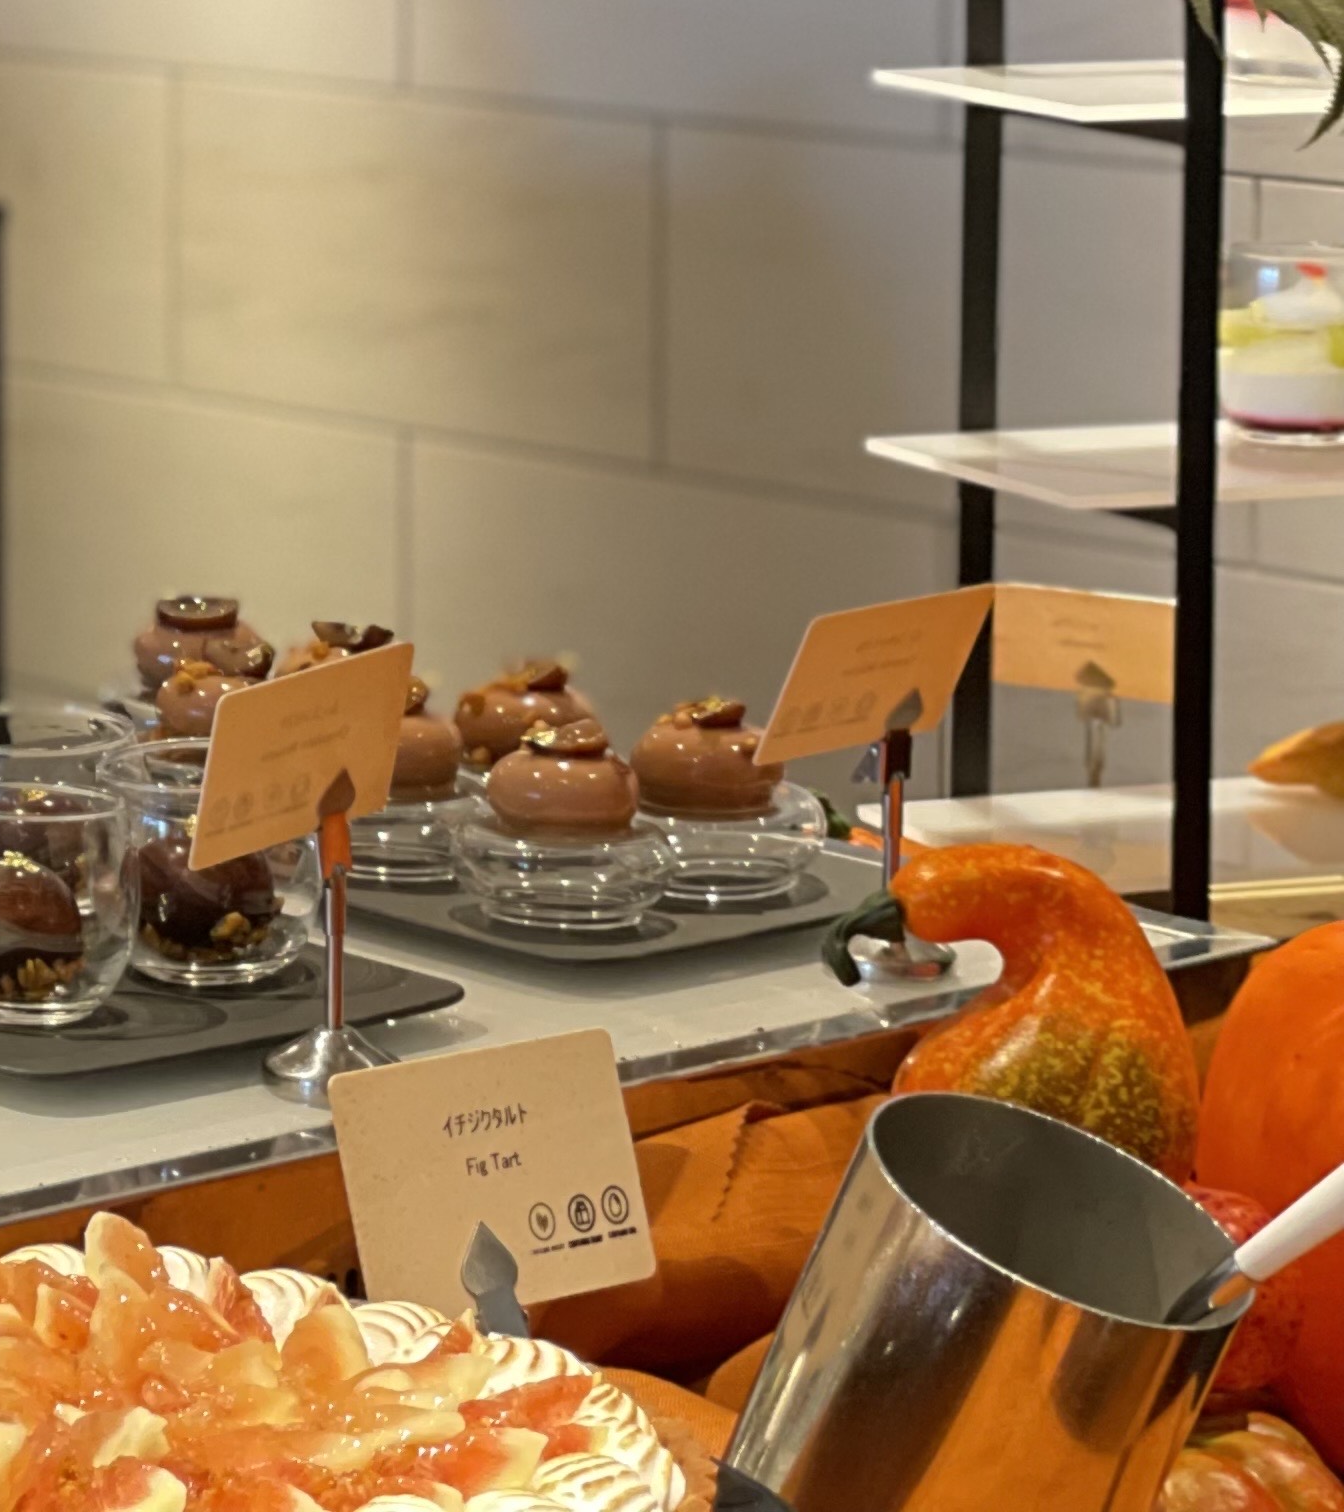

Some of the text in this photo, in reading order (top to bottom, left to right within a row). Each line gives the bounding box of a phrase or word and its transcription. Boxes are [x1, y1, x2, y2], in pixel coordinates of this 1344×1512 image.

[442, 1102, 528, 1138] イチジクタルト
[465, 1151, 523, 1177] Fig Tart
